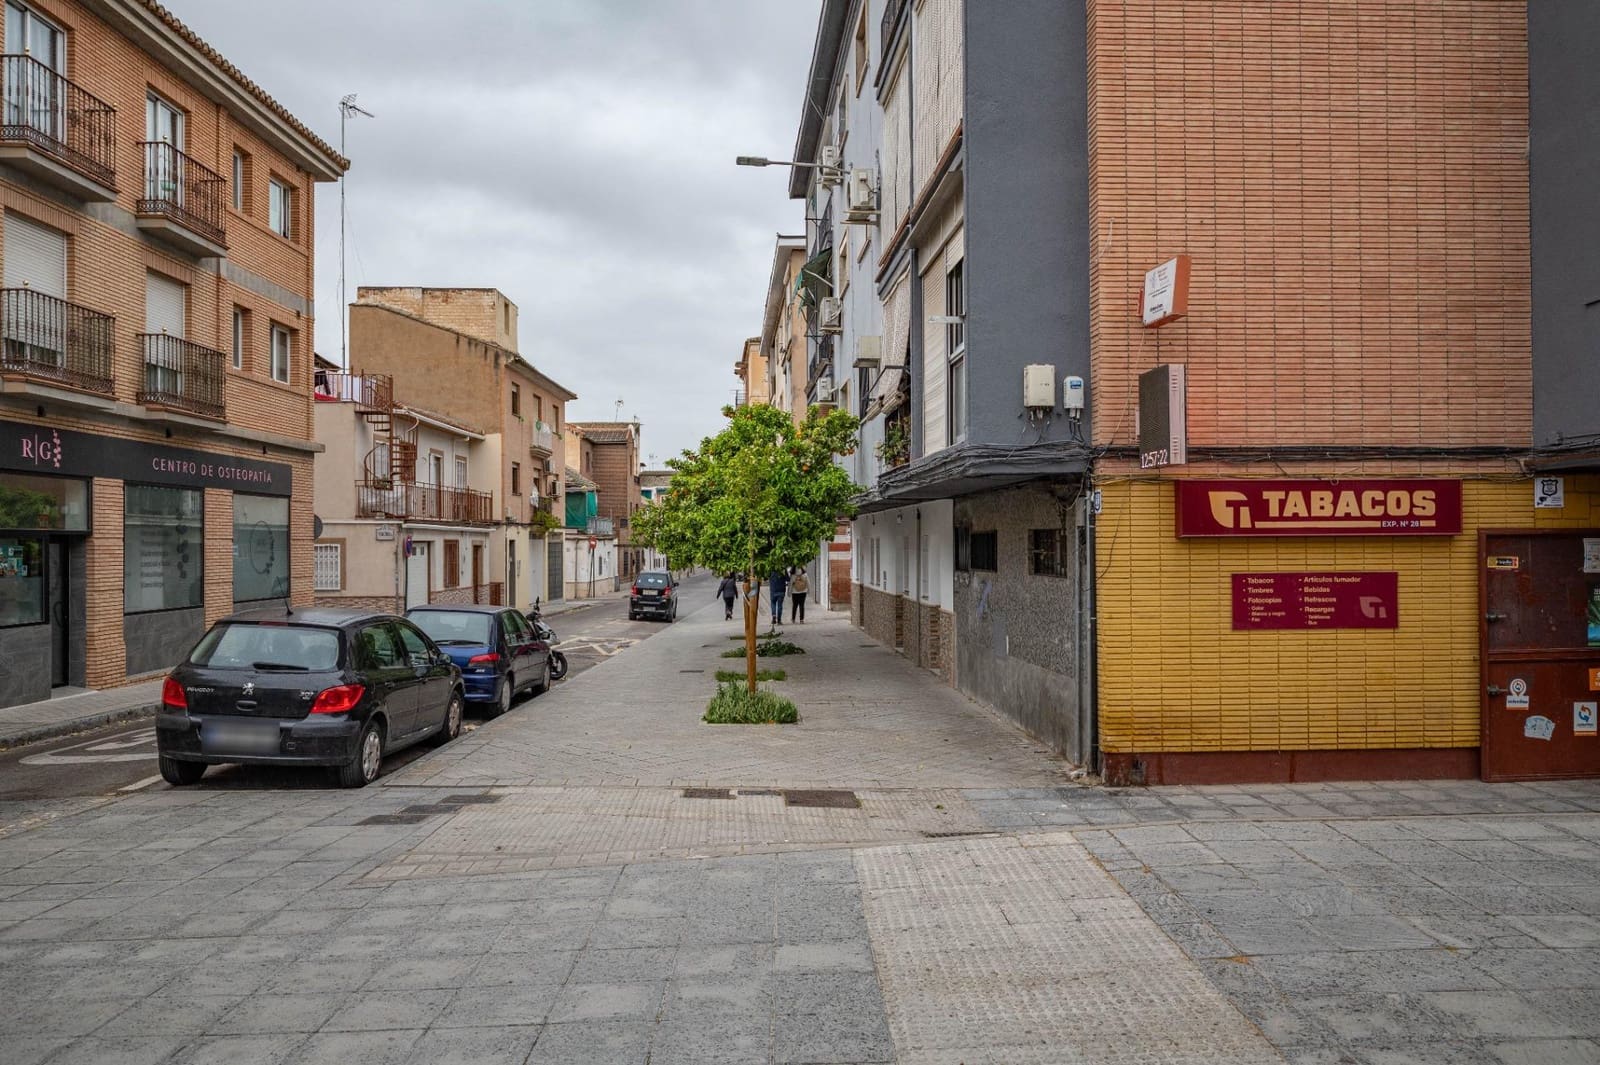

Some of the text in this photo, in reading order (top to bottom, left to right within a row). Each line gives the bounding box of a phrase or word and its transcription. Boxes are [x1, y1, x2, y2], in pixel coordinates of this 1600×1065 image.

[151, 457, 273, 483] CENTRO DE OSTEOPATÍA
[1262, 490, 1436, 518] TABACOS
[1382, 520, 1399, 528] EXP.
[1333, 575, 1361, 583] fumador
[1304, 606, 1336, 614] Recargas
